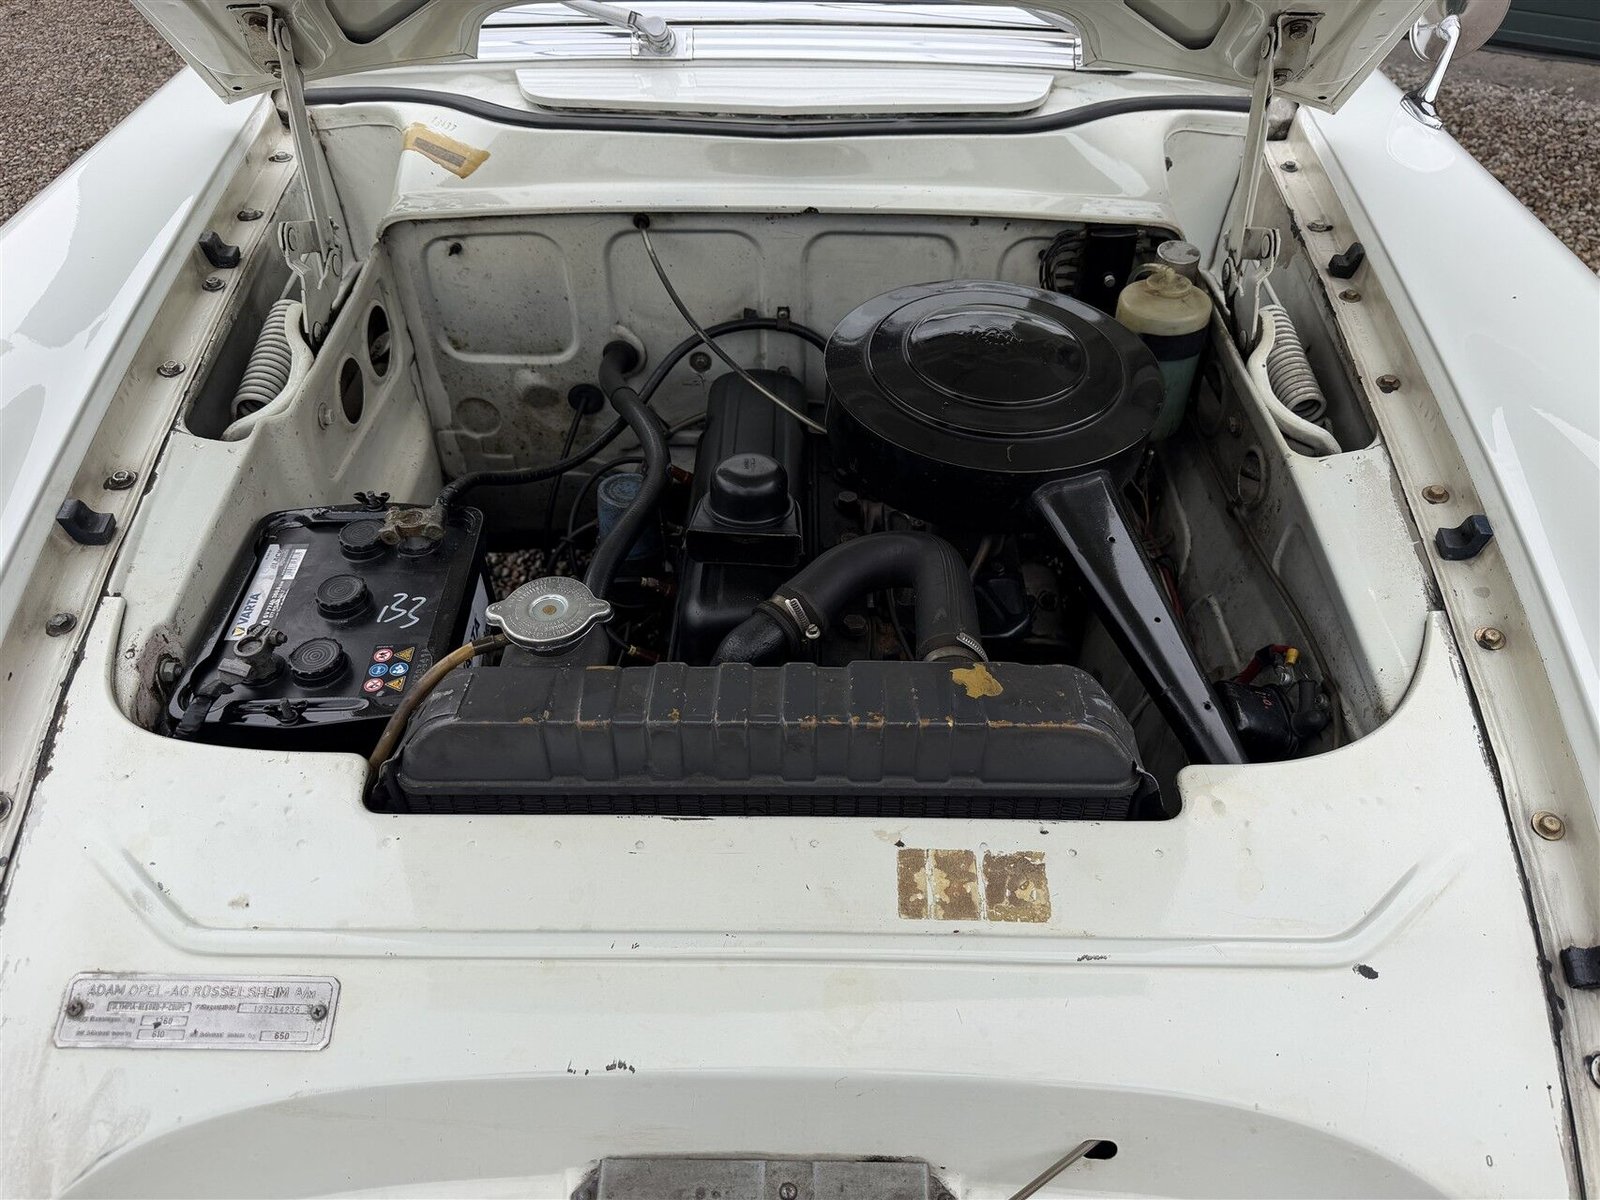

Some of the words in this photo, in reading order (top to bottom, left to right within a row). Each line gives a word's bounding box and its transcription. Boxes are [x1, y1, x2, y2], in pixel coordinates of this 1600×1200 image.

[237, 592, 261, 625] VARTA
[376, 593, 427, 629] 133
[87, 983, 126, 997] ADAM
[274, 1032, 290, 1040] 650
